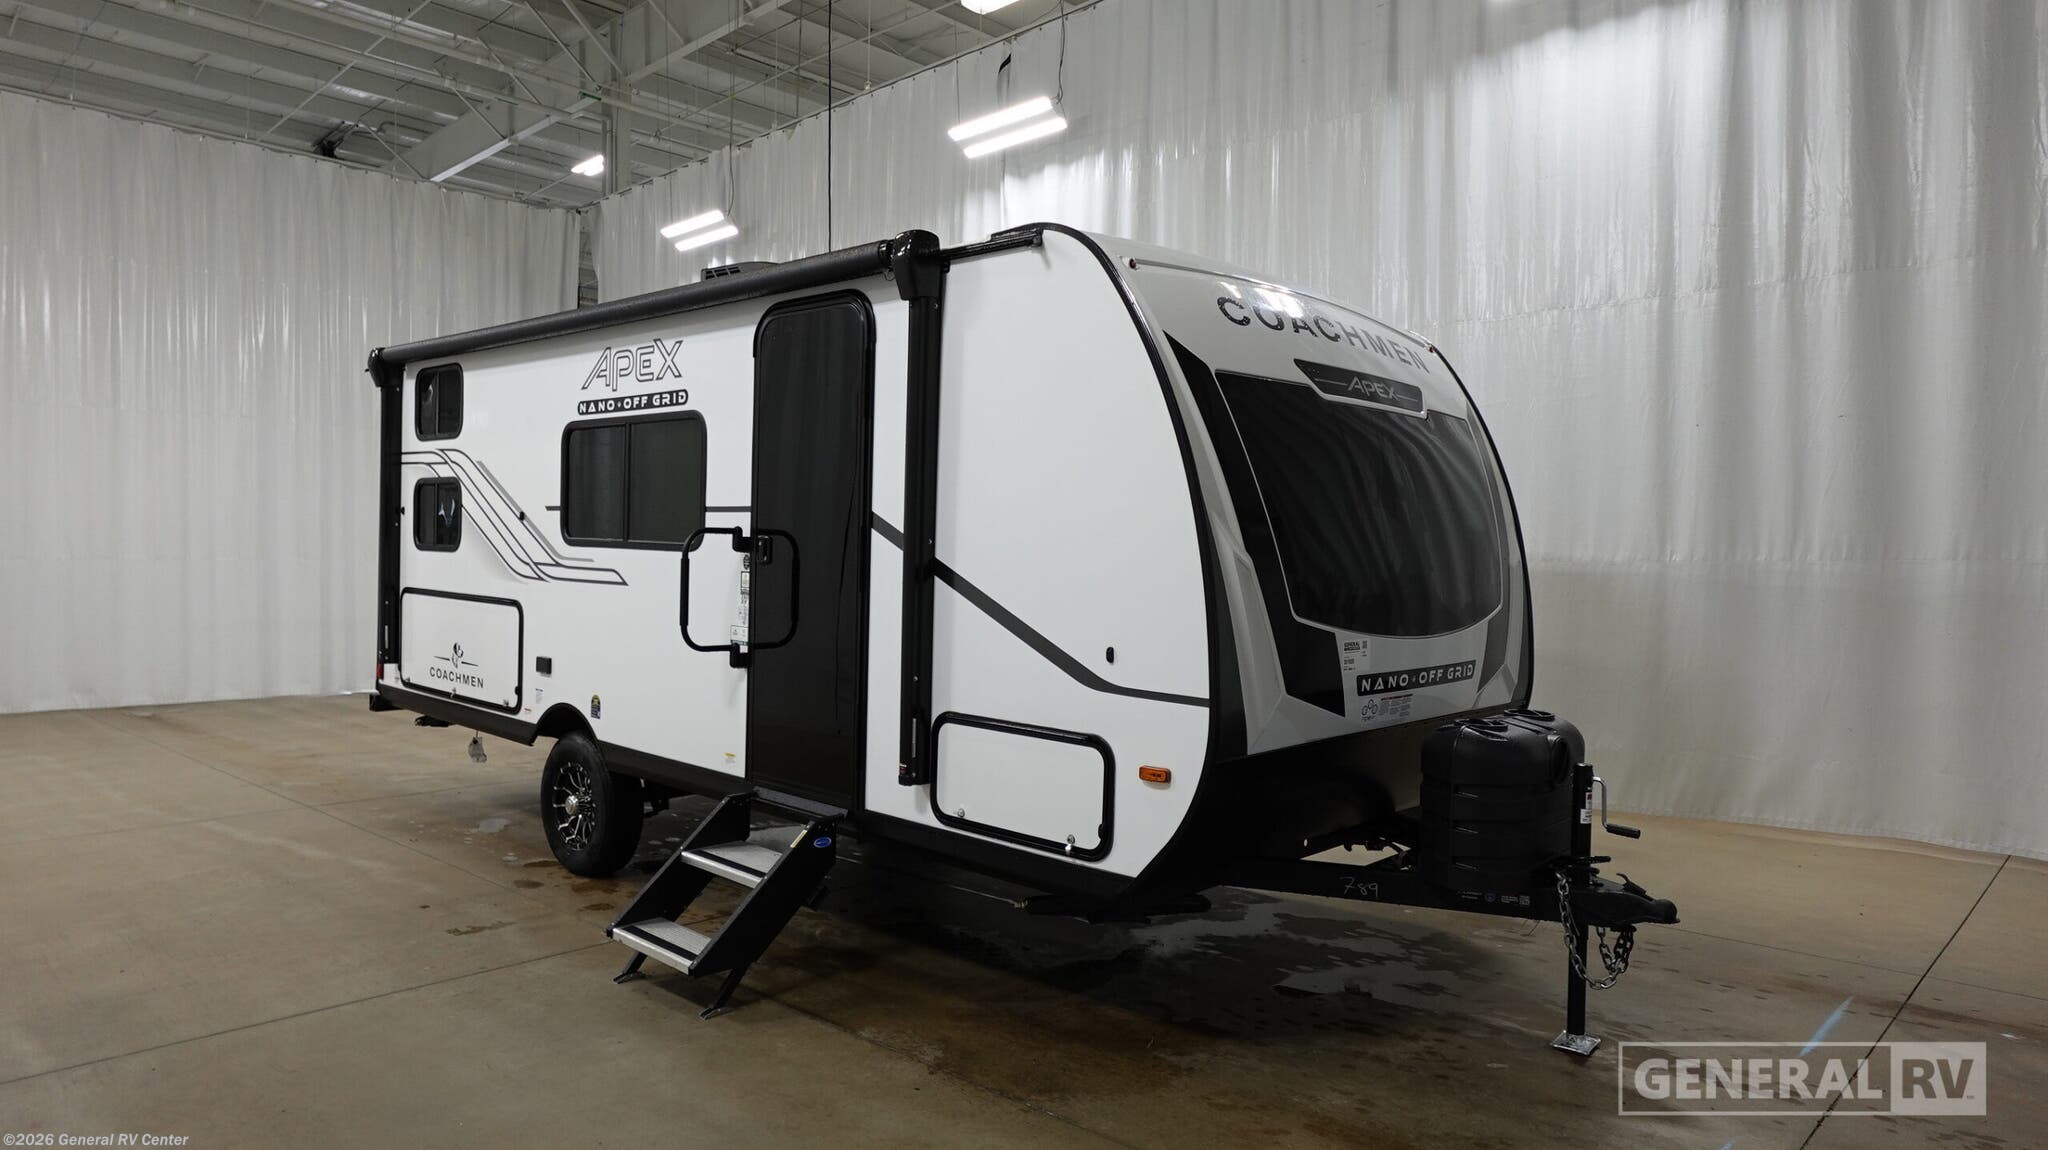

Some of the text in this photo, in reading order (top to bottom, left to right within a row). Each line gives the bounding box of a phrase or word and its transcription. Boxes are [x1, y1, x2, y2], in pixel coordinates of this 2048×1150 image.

[581, 338, 684, 392] APEX
[1347, 376, 1401, 401] APEX
[579, 391, 687, 413] NANO OFF GRID
[430, 666, 484, 689] COACHMEN
[1361, 664, 1473, 692] NANO OFF GRID
